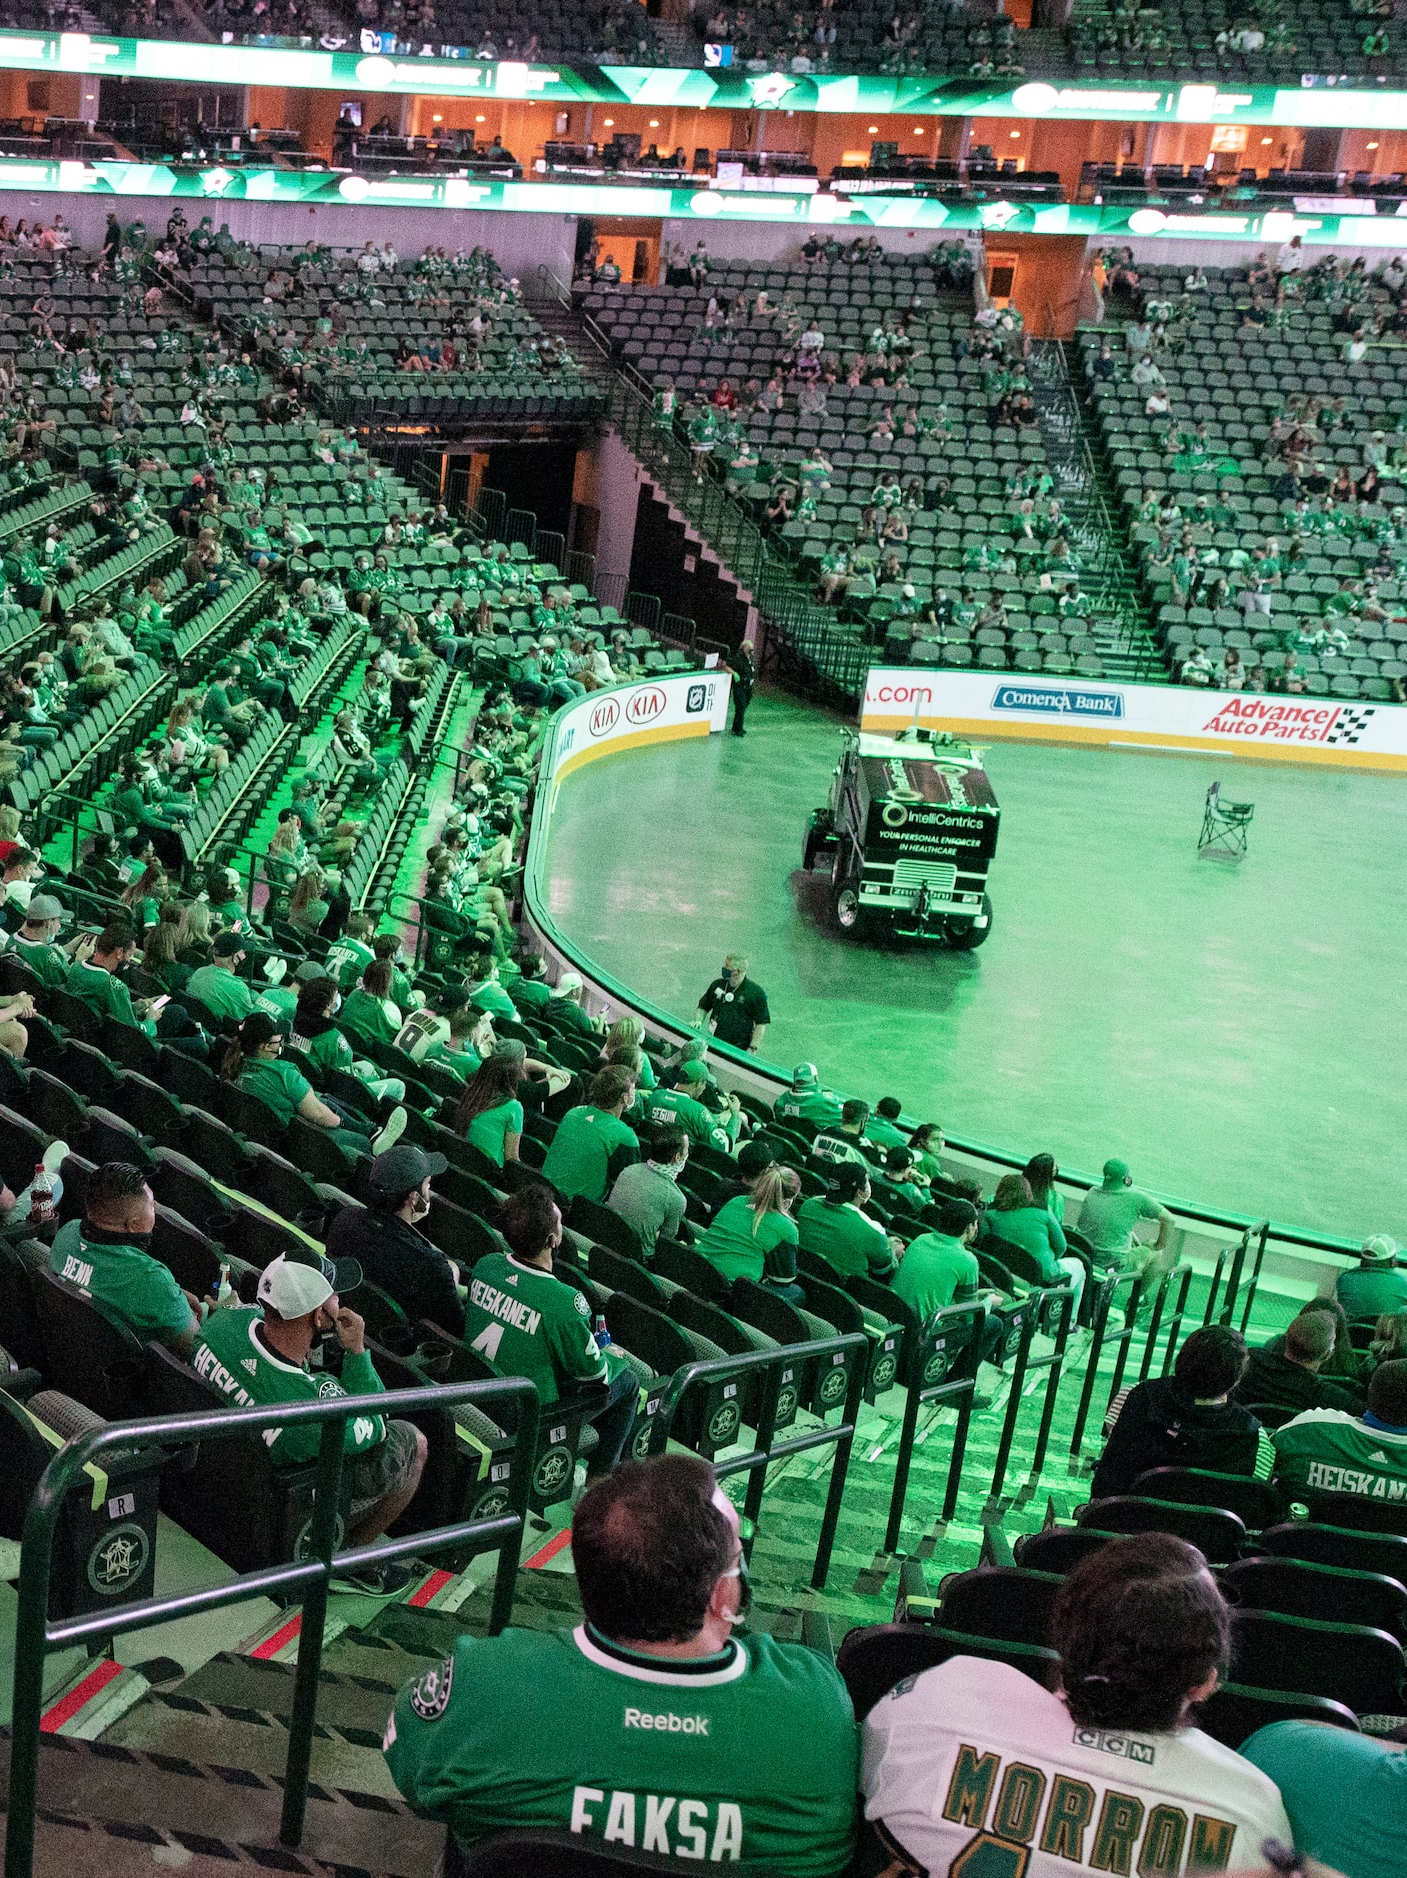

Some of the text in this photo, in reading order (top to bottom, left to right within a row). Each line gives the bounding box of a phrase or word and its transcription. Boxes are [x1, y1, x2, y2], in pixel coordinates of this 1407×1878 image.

[632, 694, 658, 718] KIA
[1075, 696, 1114, 711] Bank
[1218, 698, 1329, 724] Advance
[593, 706, 614, 730] KIA
[1202, 716, 1324, 741] Auto Parts
[908, 811, 984, 829] IntelliCentrics
[899, 843, 957, 856] IN HEALTHCARE
[901, 833, 939, 844] PERSONAL
[651, 1107, 678, 1124] SEGUIN
[61, 1254, 94, 1287] BENN
[470, 1279, 542, 1336] HEISKANEN
[1306, 1461, 1407, 1500] HEISKAN
[118, 1498, 126, 1515] R
[625, 1708, 709, 1735] Reebok
[1075, 1726, 1154, 1764] CCM
[942, 1743, 1238, 1878] MORROW
[570, 1785, 743, 1862] FAKSA
